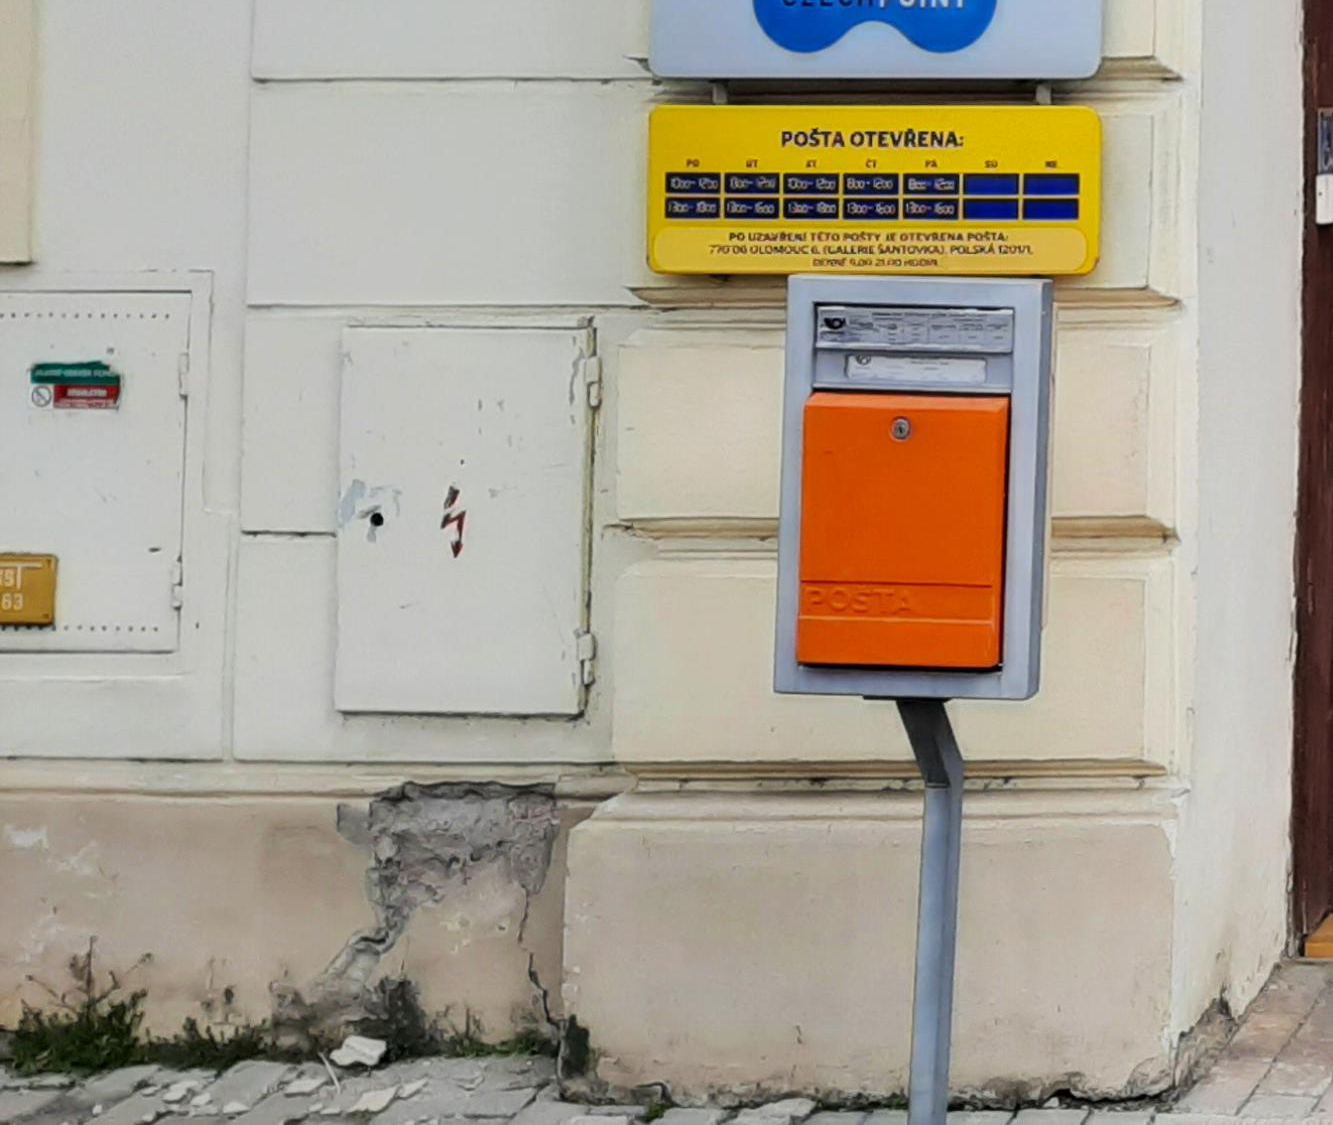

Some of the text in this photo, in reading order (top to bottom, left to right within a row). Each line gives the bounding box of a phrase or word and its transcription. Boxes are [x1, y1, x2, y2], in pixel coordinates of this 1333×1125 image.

[781, 128, 964, 148] POŠTA OTEVŘENA:
[729, 232, 745, 242] PO
[842, 231, 880, 242] POŠTY
[899, 231, 964, 242] OTEVŘENA
[750, 244, 809, 255] OLOMOUC
[950, 244, 996, 255] POLSKÁ
[803, 583, 914, 615] POŠTA
